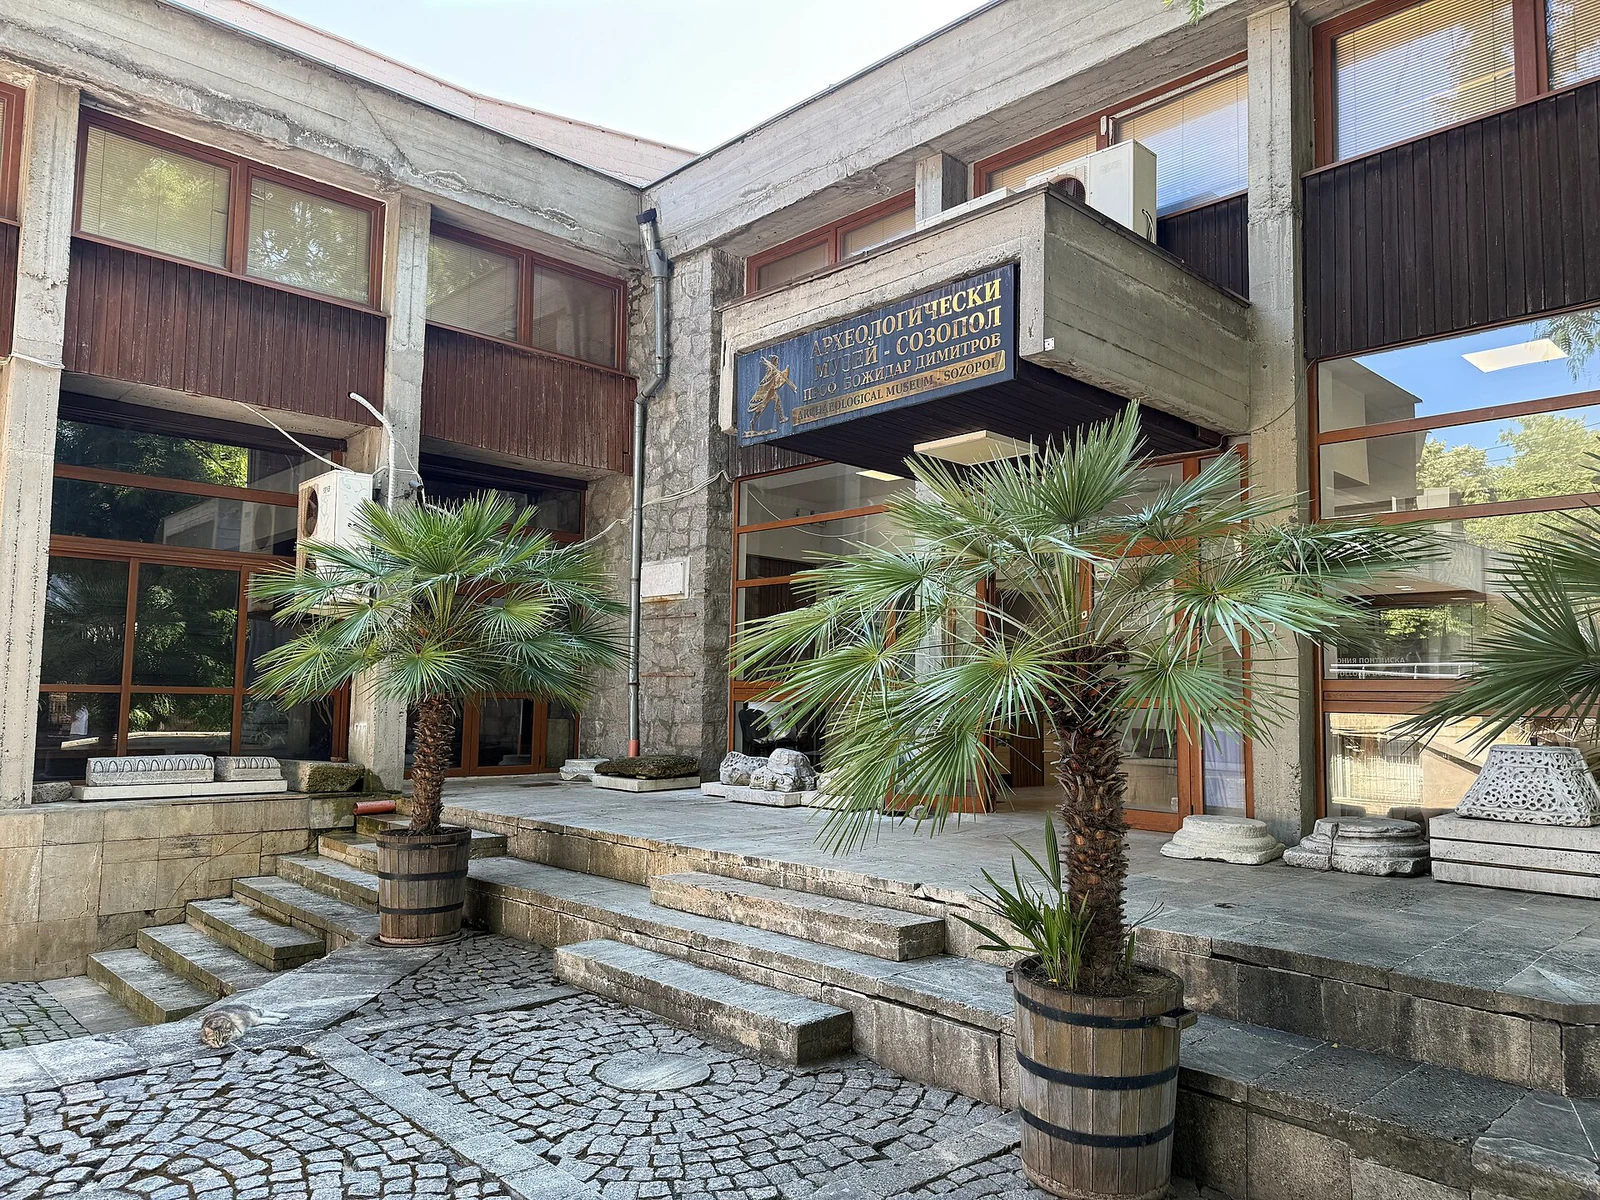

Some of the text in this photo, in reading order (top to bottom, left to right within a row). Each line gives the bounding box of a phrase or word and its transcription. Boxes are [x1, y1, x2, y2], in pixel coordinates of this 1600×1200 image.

[810, 278, 1001, 359] АРХЕОЛОГИЧЕСКИ
[815, 340, 878, 381] МУЗЕЙ
[896, 305, 1001, 356] СОЗОПОЛ
[797, 389, 883, 420] ARCHAEOLOGICAL
[886, 375, 933, 398] MUSEUM
[944, 357, 999, 381] SOZOPOL
[844, 359, 912, 391] БОЖИДАР
[915, 332, 1001, 372] ДИМИТРОВ
